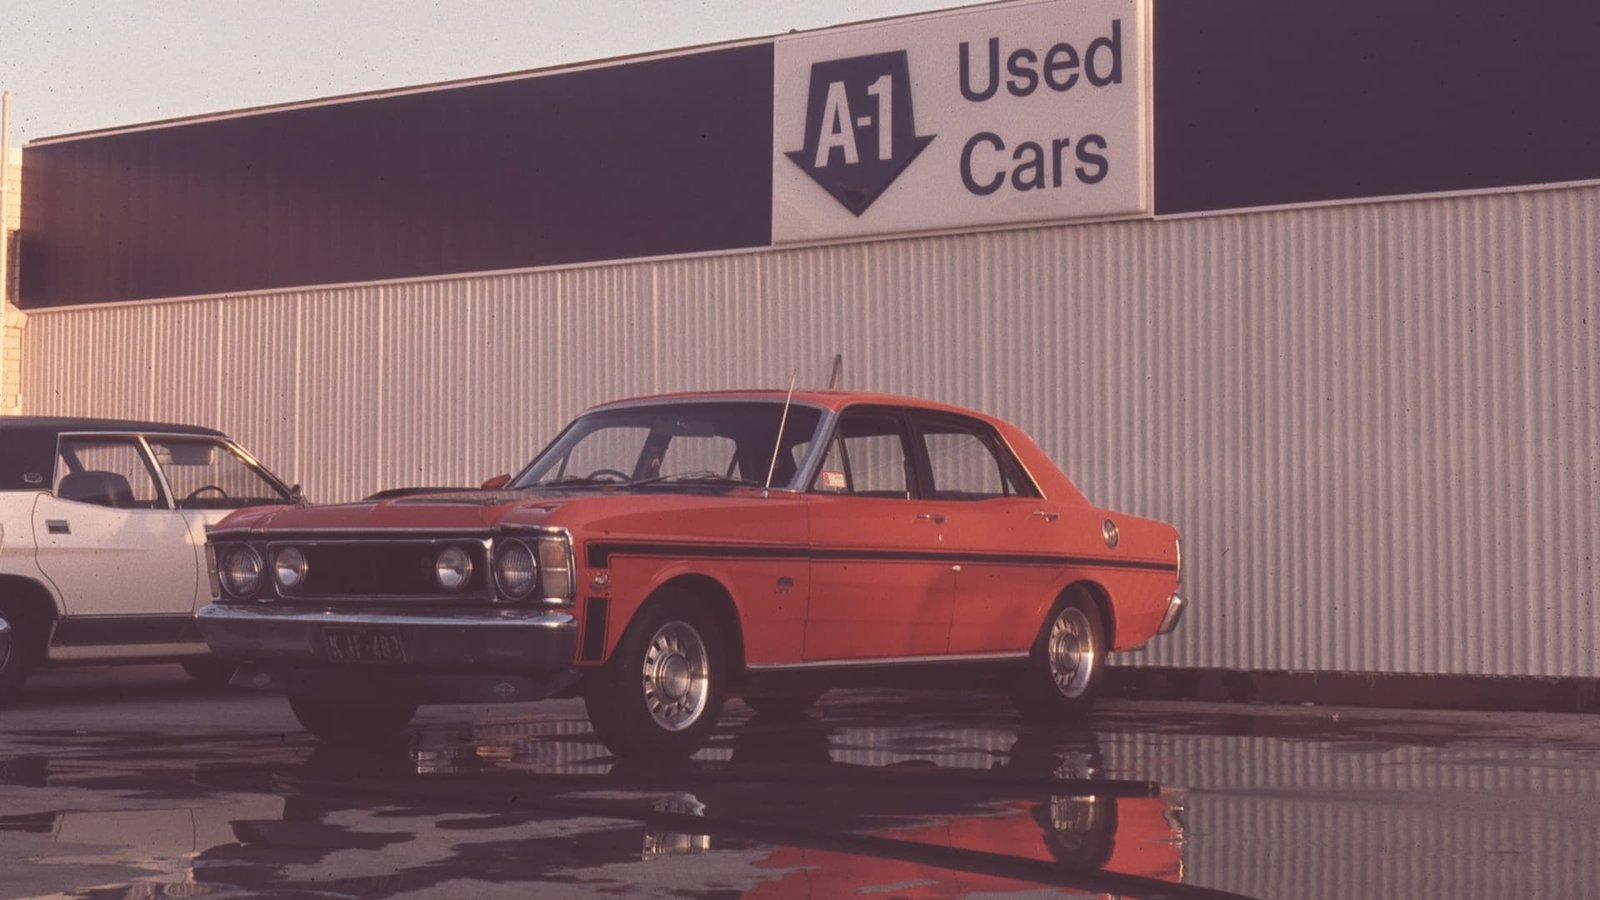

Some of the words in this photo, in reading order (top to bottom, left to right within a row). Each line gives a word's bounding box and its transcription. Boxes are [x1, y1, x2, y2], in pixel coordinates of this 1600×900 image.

[959, 19, 1123, 102] Used
[814, 74, 893, 169] A-1
[959, 131, 1109, 196] Cars
